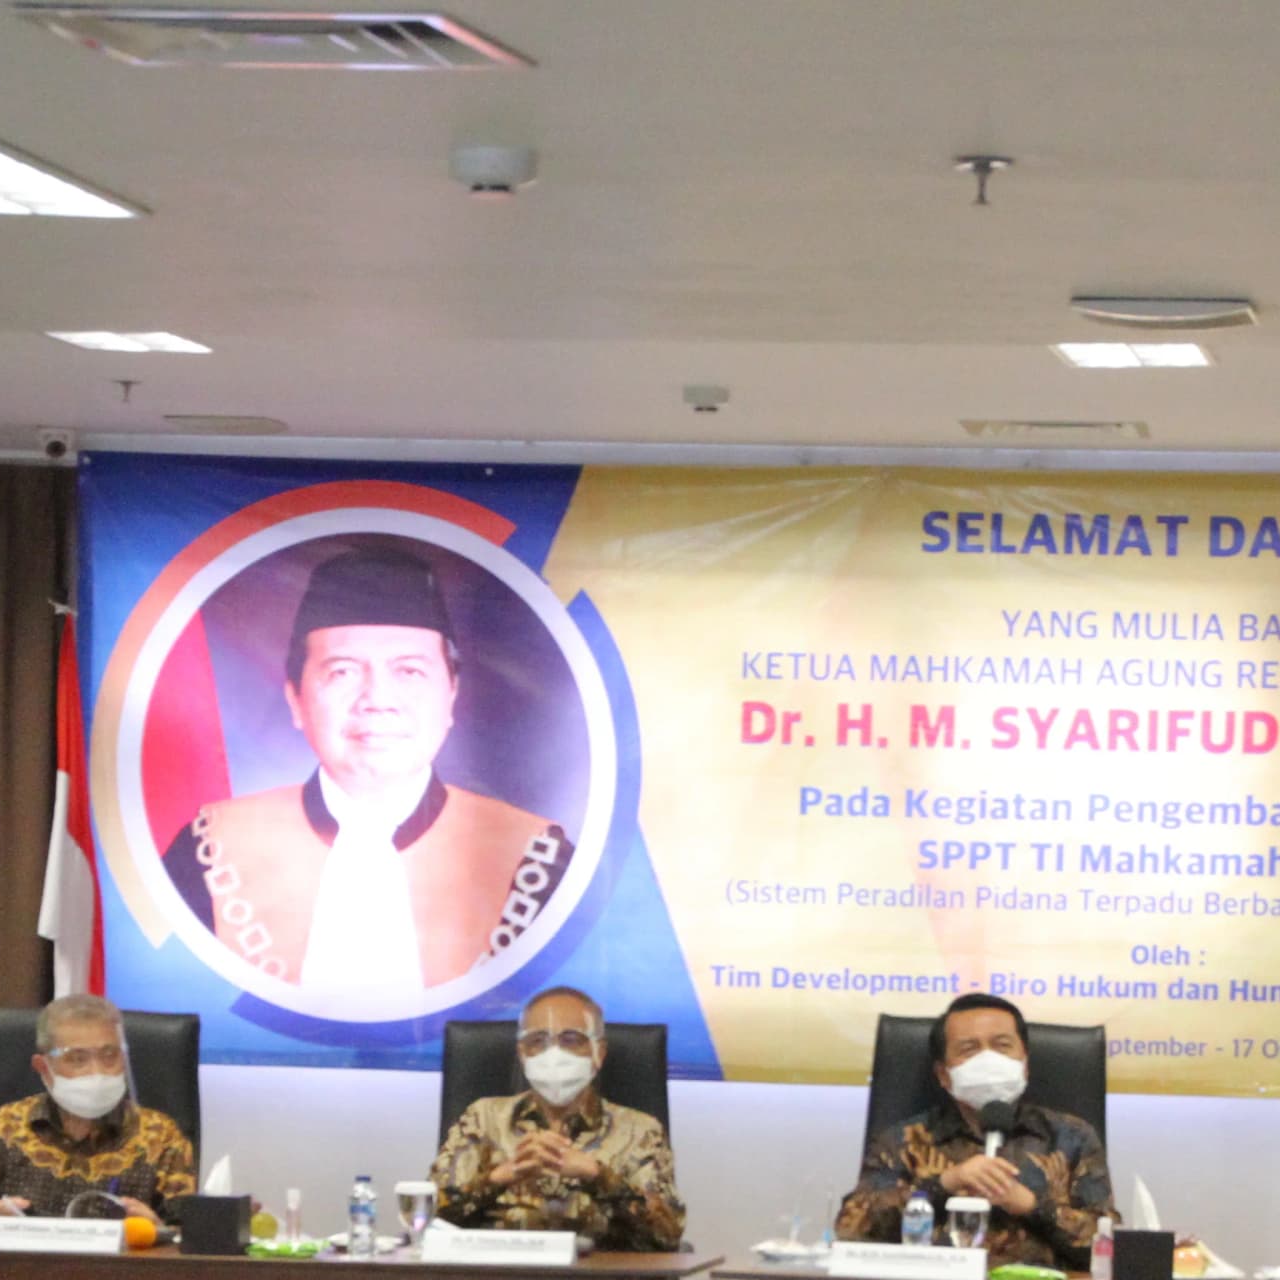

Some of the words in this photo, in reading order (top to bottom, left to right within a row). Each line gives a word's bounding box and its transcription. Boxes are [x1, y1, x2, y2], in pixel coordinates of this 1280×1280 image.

[921, 510, 1189, 557] SELAMAT
[1001, 609, 1098, 639] YANG
[1112, 610, 1224, 641] MULIA
[741, 652, 856, 681] KETUA
[870, 654, 1082, 684] MAHKAMAH
[1097, 659, 1222, 688] AGUNG
[741, 701, 815, 747] Dr.
[836, 703, 888, 749] H.
[909, 704, 970, 749] M.
[800, 786, 890, 817] Pada
[905, 788, 1072, 825] Kegiatan
[918, 840, 1016, 870] SPPT
[1030, 843, 1064, 872] TI
[725, 879, 826, 905] (Sistem
[837, 882, 965, 909] Peradilan
[976, 886, 1068, 911] Pidana
[1079, 889, 1193, 917] Terpadu
[1131, 944, 1190, 966] Oleh
[710, 965, 761, 988] Tim
[771, 967, 961, 996] Development
[989, 972, 1047, 997] Biro
[1057, 975, 1158, 1000] Hukum
[1167, 976, 1219, 1000] dan
[1107, 1035, 1208, 1059] ptember
[1233, 1038, 1254, 1059] 17
